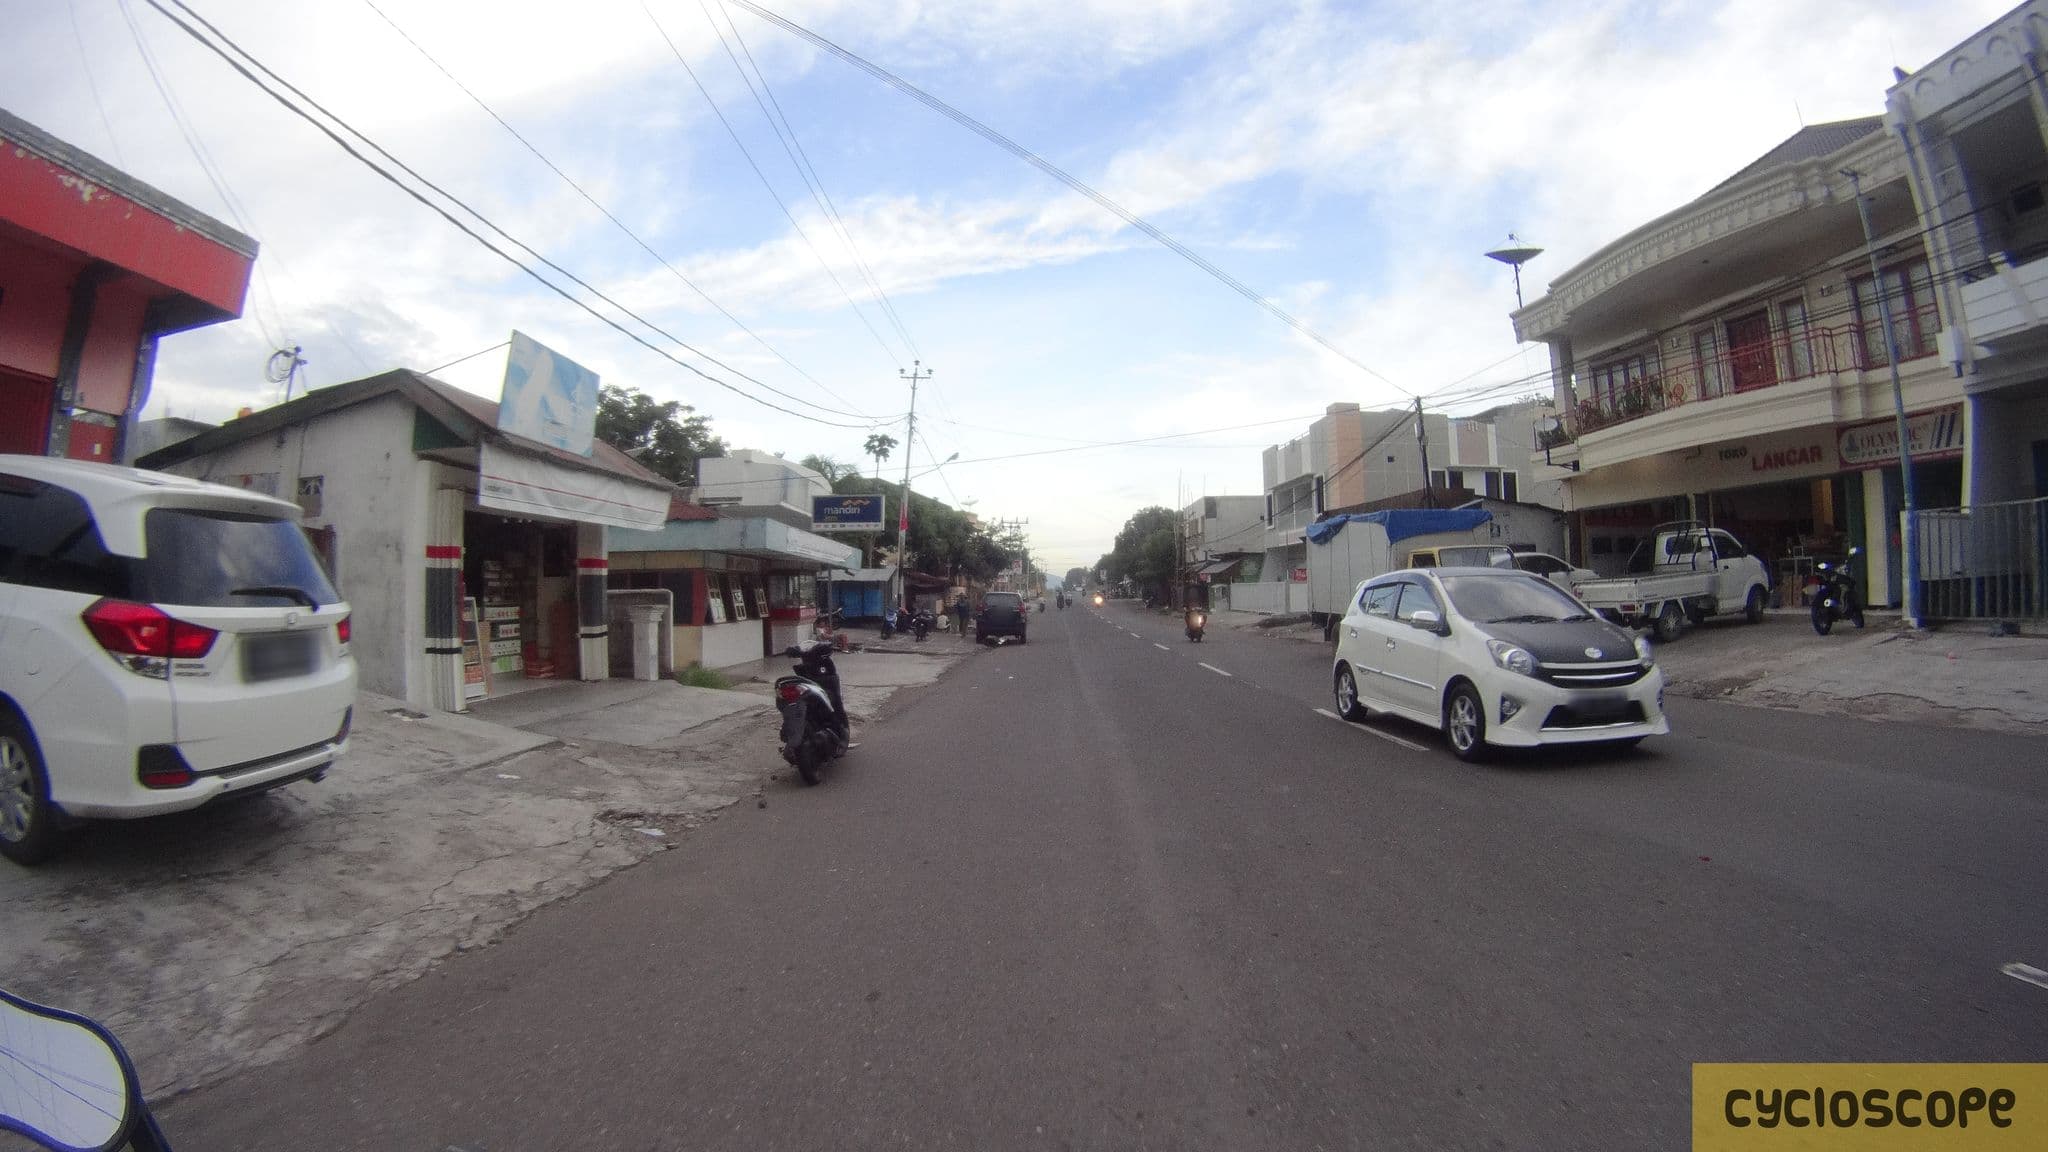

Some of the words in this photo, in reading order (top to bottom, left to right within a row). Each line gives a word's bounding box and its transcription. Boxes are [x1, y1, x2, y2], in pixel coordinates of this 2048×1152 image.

[1860, 427, 1921, 448] OLYMIC
[1718, 446, 1748, 461] TOKO
[1751, 446, 1823, 471] LANCAR
[824, 505, 861, 514] mandiri
